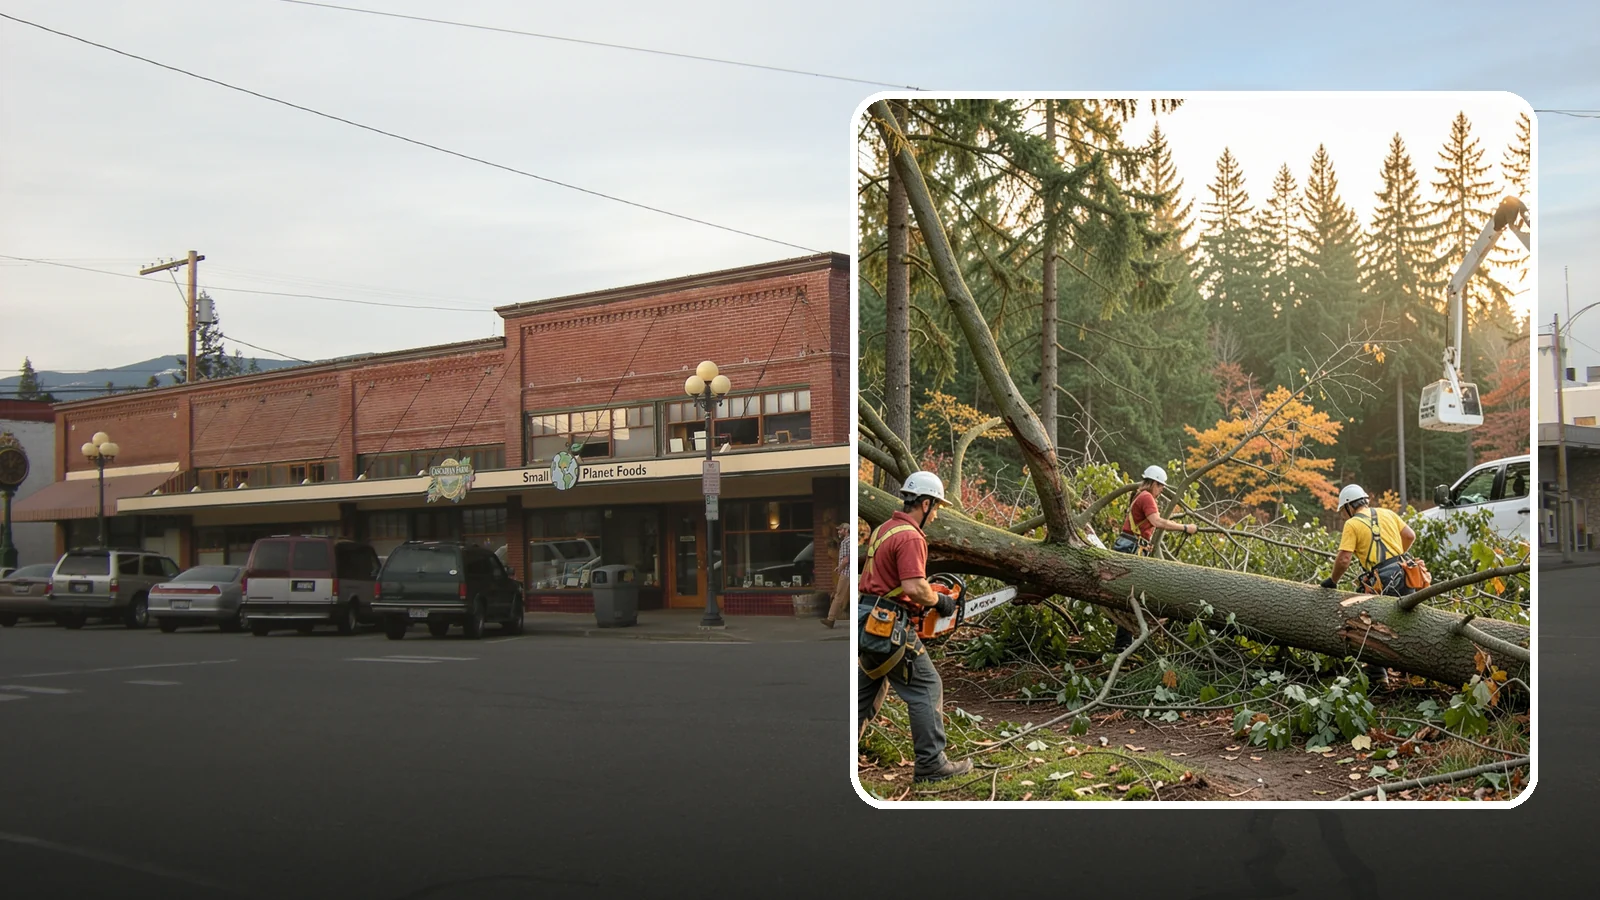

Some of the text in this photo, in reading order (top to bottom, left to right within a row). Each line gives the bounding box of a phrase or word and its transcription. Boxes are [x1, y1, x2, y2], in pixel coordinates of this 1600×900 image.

[523, 464, 647, 483] Small Planet Foods
